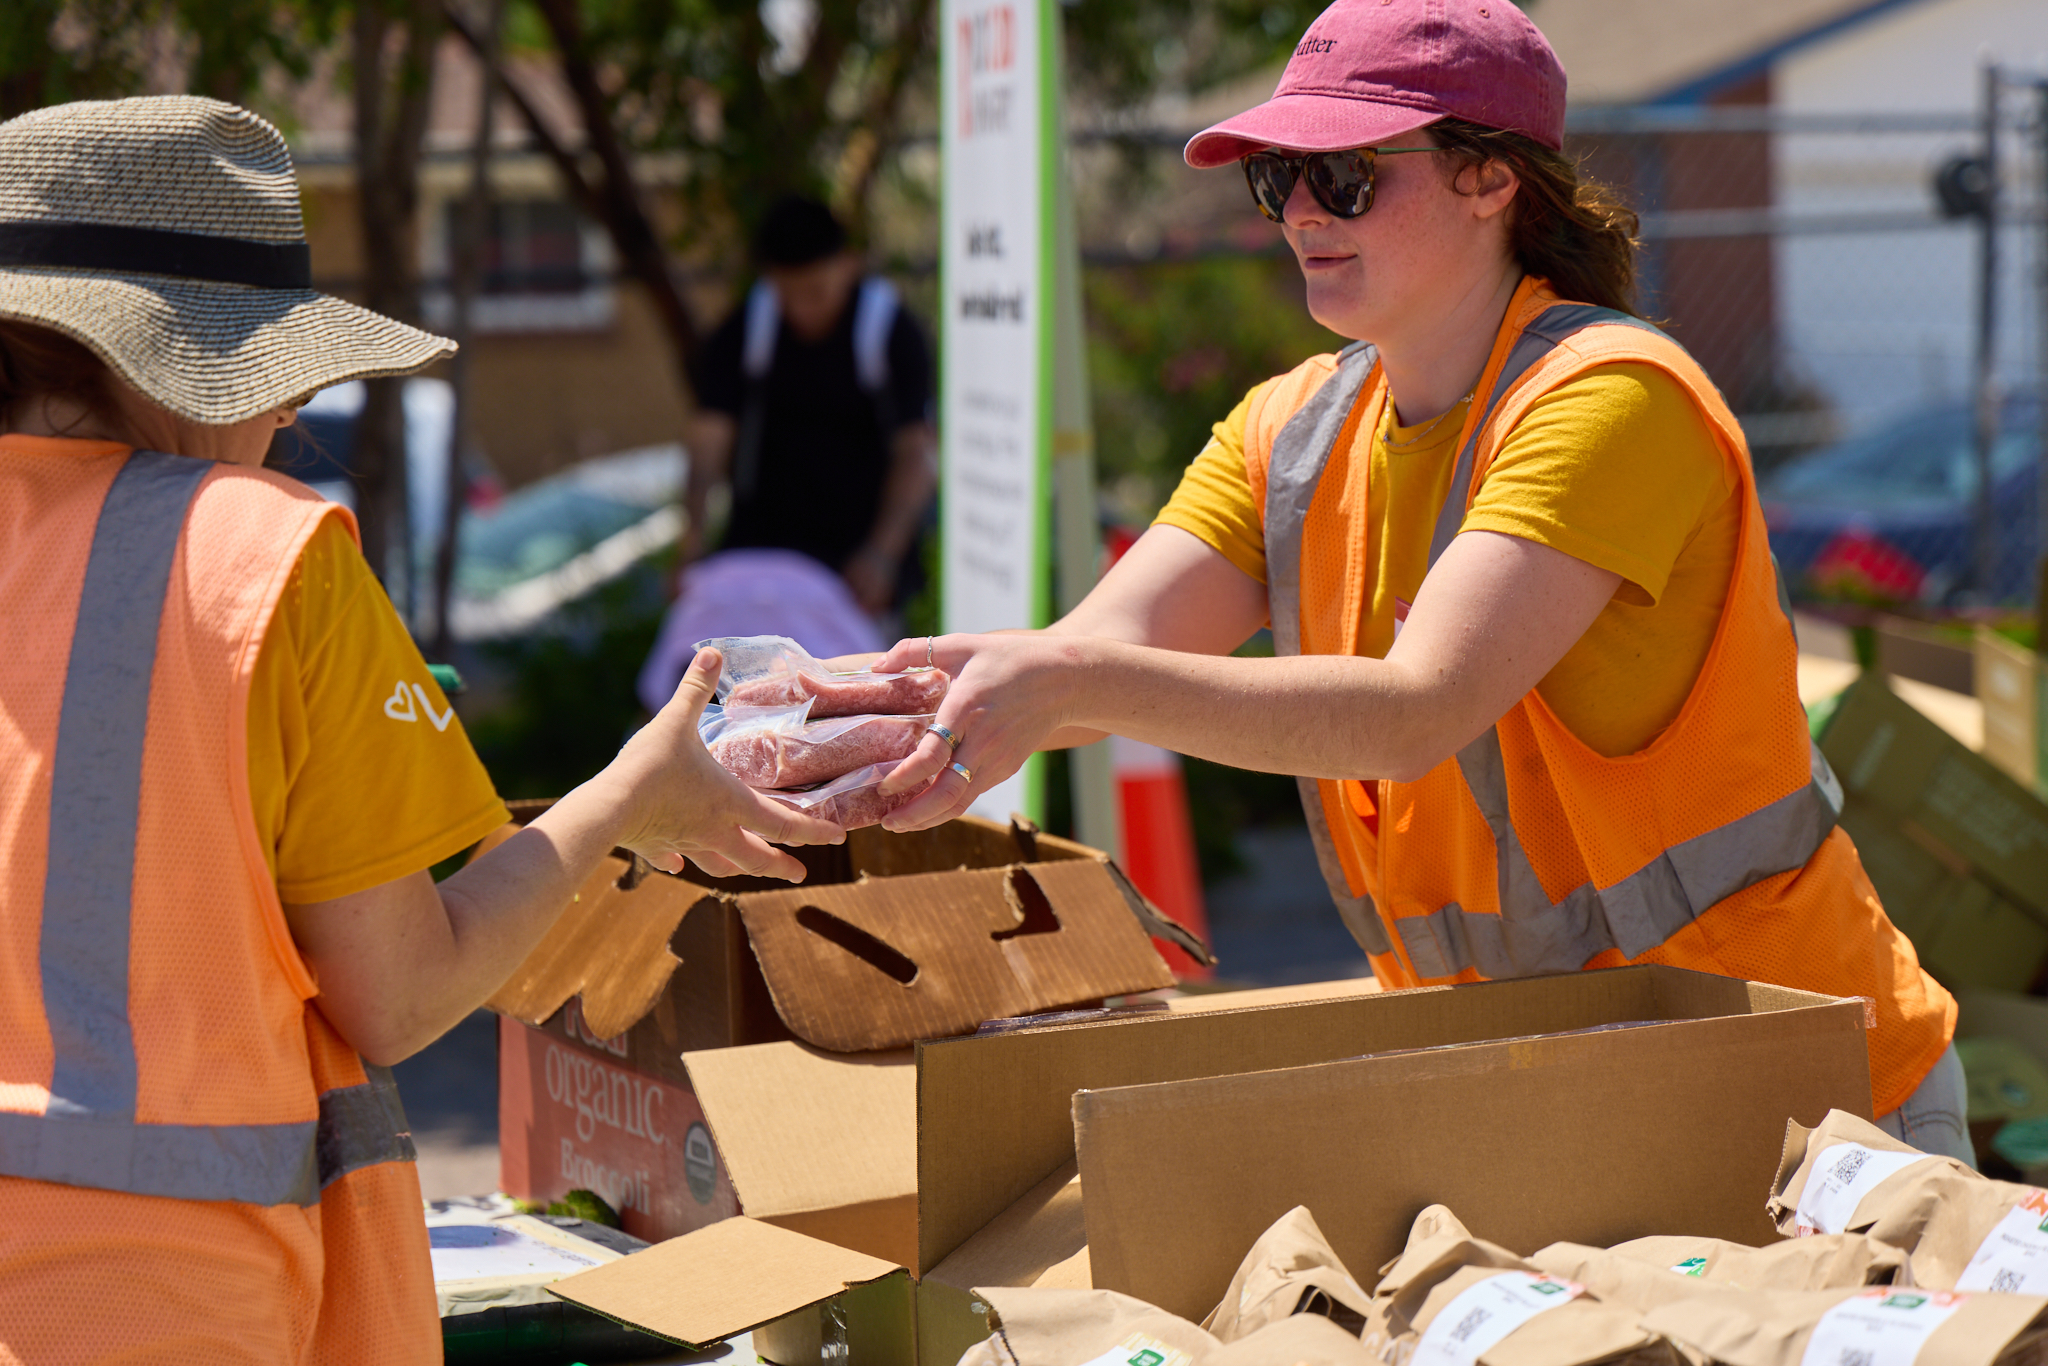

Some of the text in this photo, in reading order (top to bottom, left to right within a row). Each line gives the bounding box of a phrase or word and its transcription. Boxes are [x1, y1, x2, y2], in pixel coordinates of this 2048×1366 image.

[1293, 36, 1337, 56] utter
[546, 1045, 663, 1144] organic
[560, 1138, 649, 1215] Broccoli
